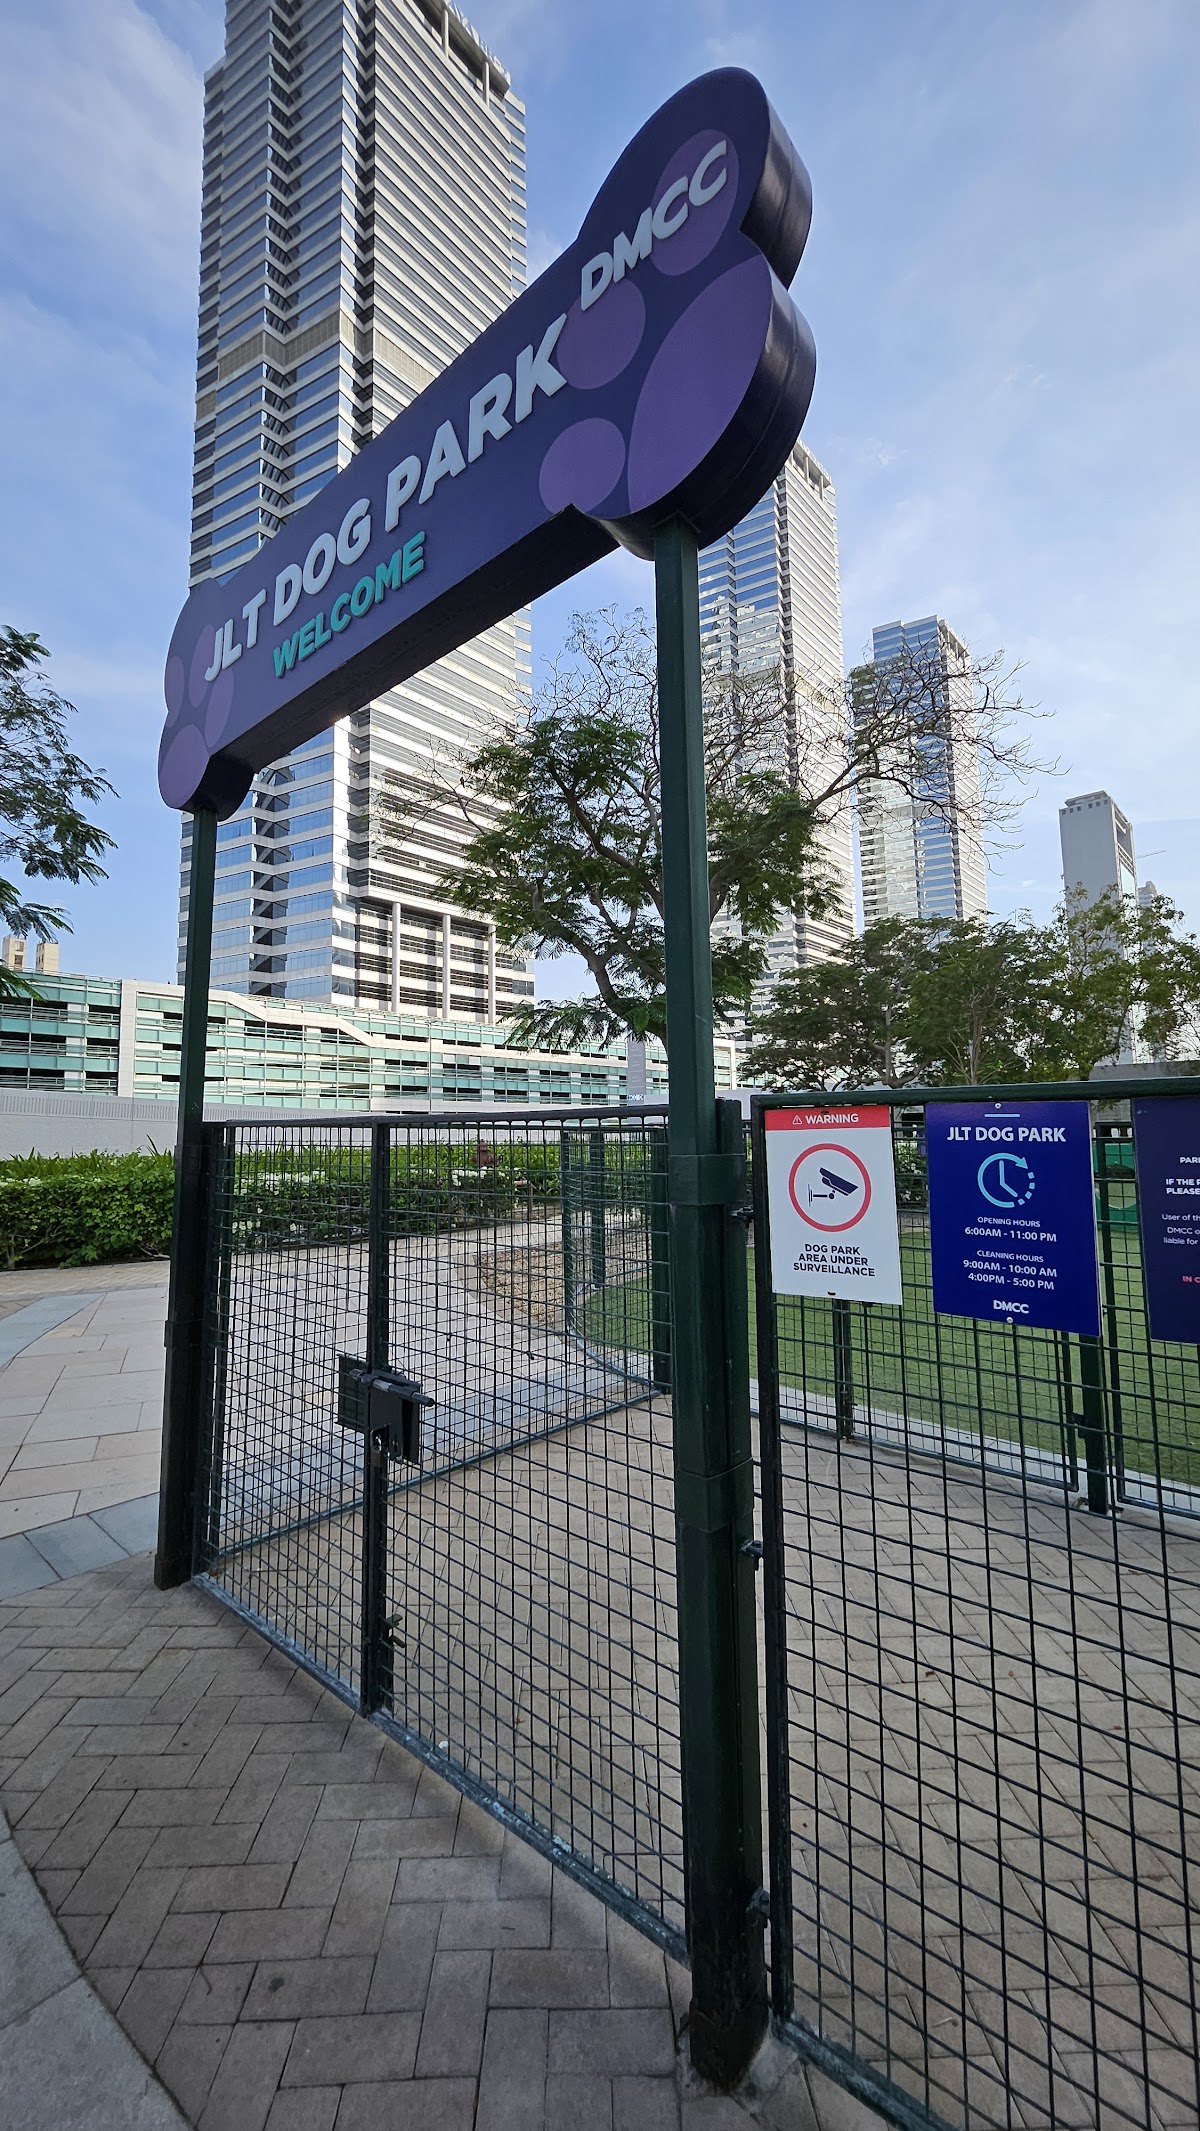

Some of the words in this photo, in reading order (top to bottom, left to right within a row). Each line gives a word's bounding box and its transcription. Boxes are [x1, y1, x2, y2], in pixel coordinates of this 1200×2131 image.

[581, 140, 726, 311] DMCC
[204, 589, 267, 682] JLT
[273, 498, 371, 627] DOG
[385, 313, 567, 533] PARK
[273, 531, 425, 677] WELCOME
[805, 1113, 859, 1125] WARNING
[947, 1126, 972, 1141] JLT
[975, 1126, 1014, 1142] DOG
[1018, 1127, 1066, 1142] PARK
[1165, 1178, 1175, 1186] IF
[1176, 1178, 1195, 1186] THE
[1166, 1187, 1200, 1195] PLEASE
[977, 1216, 1012, 1225] OPENING
[1012, 1219, 1040, 1228] HOURS
[1161, 1213, 1180, 1221] User
[1182, 1213, 1191, 1221] of
[964, 1226, 1002, 1238] 6:00AM
[1010, 1230, 1038, 1240] 11:00
[1040, 1232, 1057, 1242] PM
[1166, 1226, 1193, 1235] DMCC
[1163, 1236, 1185, 1245] liable
[1186, 1237, 1198, 1245] for
[804, 1243, 828, 1253] DOG
[831, 1245, 860, 1256] PARK
[976, 1249, 1015, 1260] CLEANING
[1015, 1254, 1044, 1263] HOURS
[798, 1253, 827, 1263] AREA
[830, 1255, 868, 1266] UNDER
[793, 1262, 876, 1277] SURVEILLANCE
[963, 1259, 1001, 1271] 9:00AM
[1008, 1264, 1037, 1275] 10:00
[1038, 1267, 1057, 1278] AM
[968, 1272, 1005, 1284] 4:00PM
[1012, 1277, 1035, 1288] 5:00
[1037, 1280, 1055, 1290] PM
[1182, 1275, 1192, 1283] IN
[993, 1299, 1030, 1314] DMCC
